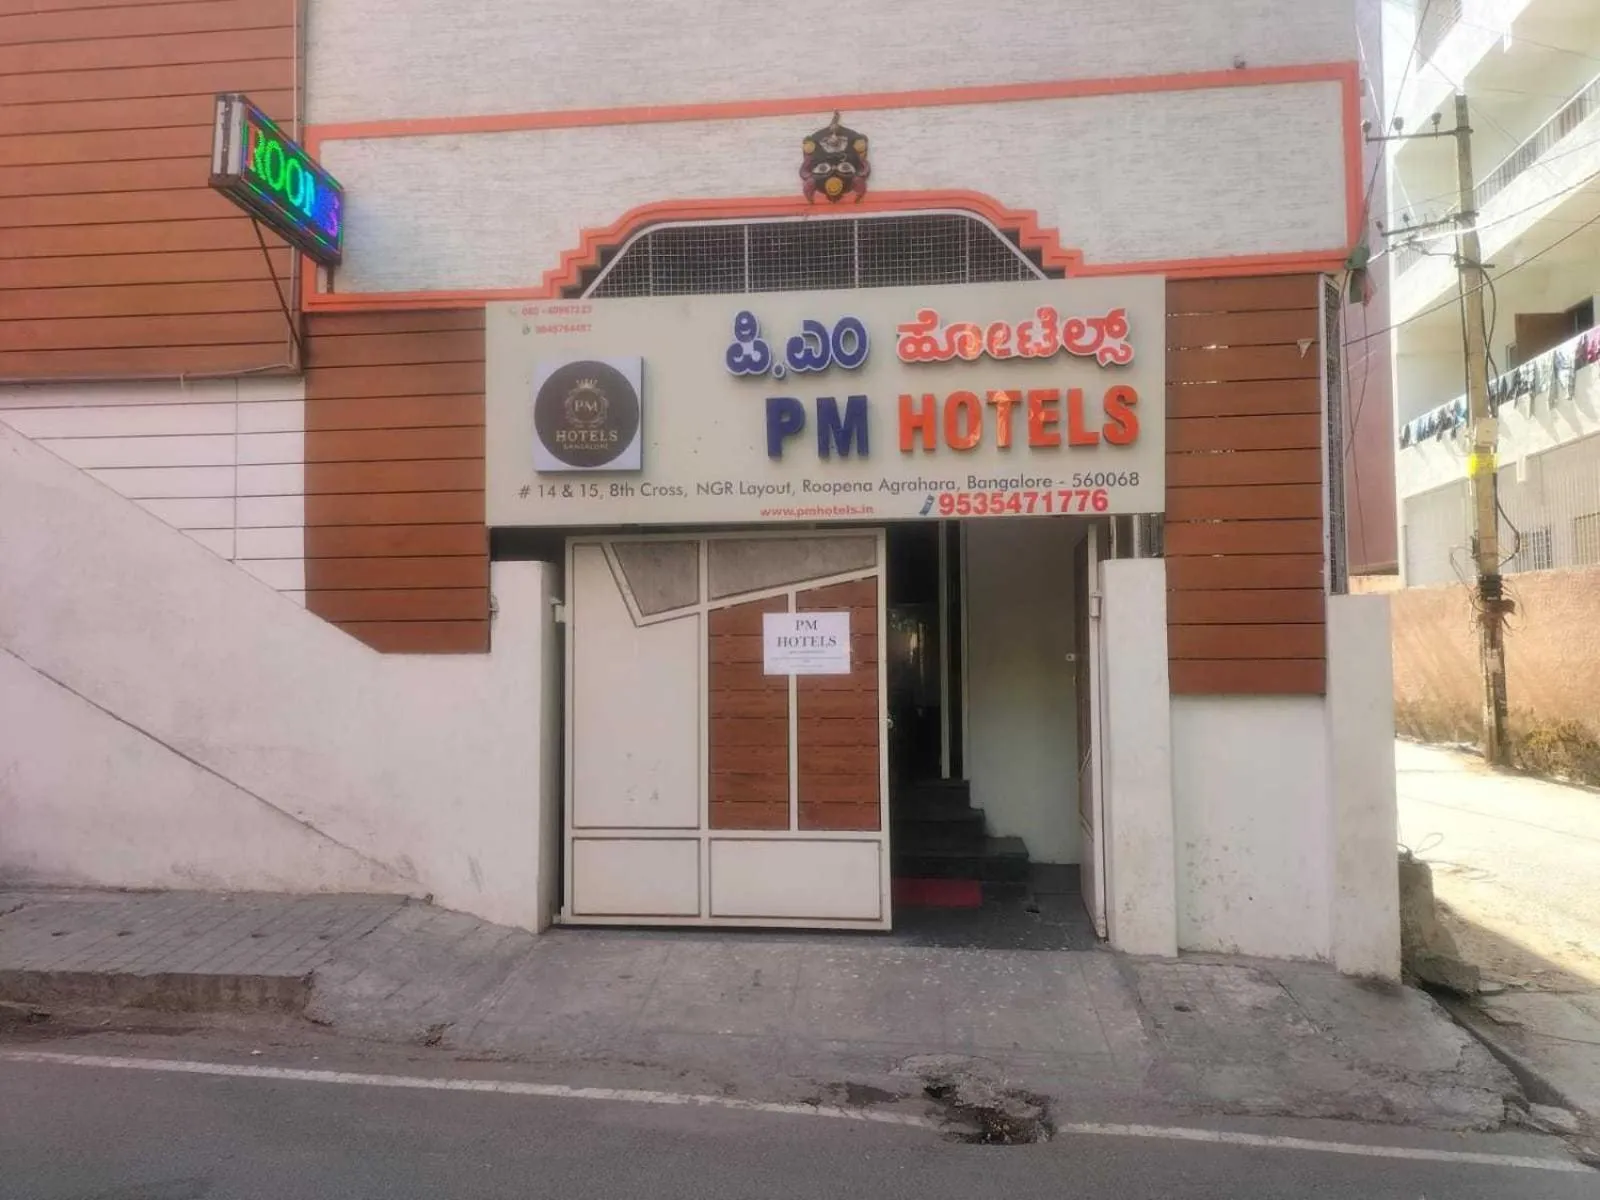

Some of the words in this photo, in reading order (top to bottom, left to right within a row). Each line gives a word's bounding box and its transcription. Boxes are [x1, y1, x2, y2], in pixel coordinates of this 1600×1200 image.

[574, 400, 598, 412] PM
[765, 394, 869, 460] PM
[897, 384, 1140, 455] HOTELS
[555, 430, 618, 442] HOTELS
[518, 484, 531, 499] #
[538, 484, 556, 498] 14
[562, 483, 574, 498] &
[579, 482, 604, 500] 15,
[609, 480, 635, 497] 8th
[640, 481, 688, 498] Cross,
[696, 480, 734, 496] NGR
[739, 480, 796, 498] Layout,
[802, 478, 873, 496] Roopena
[878, 476, 961, 494] Agrahara,
[967, 473, 1053, 492] Bangalore
[1071, 472, 1140, 488] 560068
[938, 488, 1109, 516] 9535471776
[760, 504, 875, 518] www.pmhotels.in
[796, 620, 818, 631] PM
[776, 636, 837, 648] HOTELS
